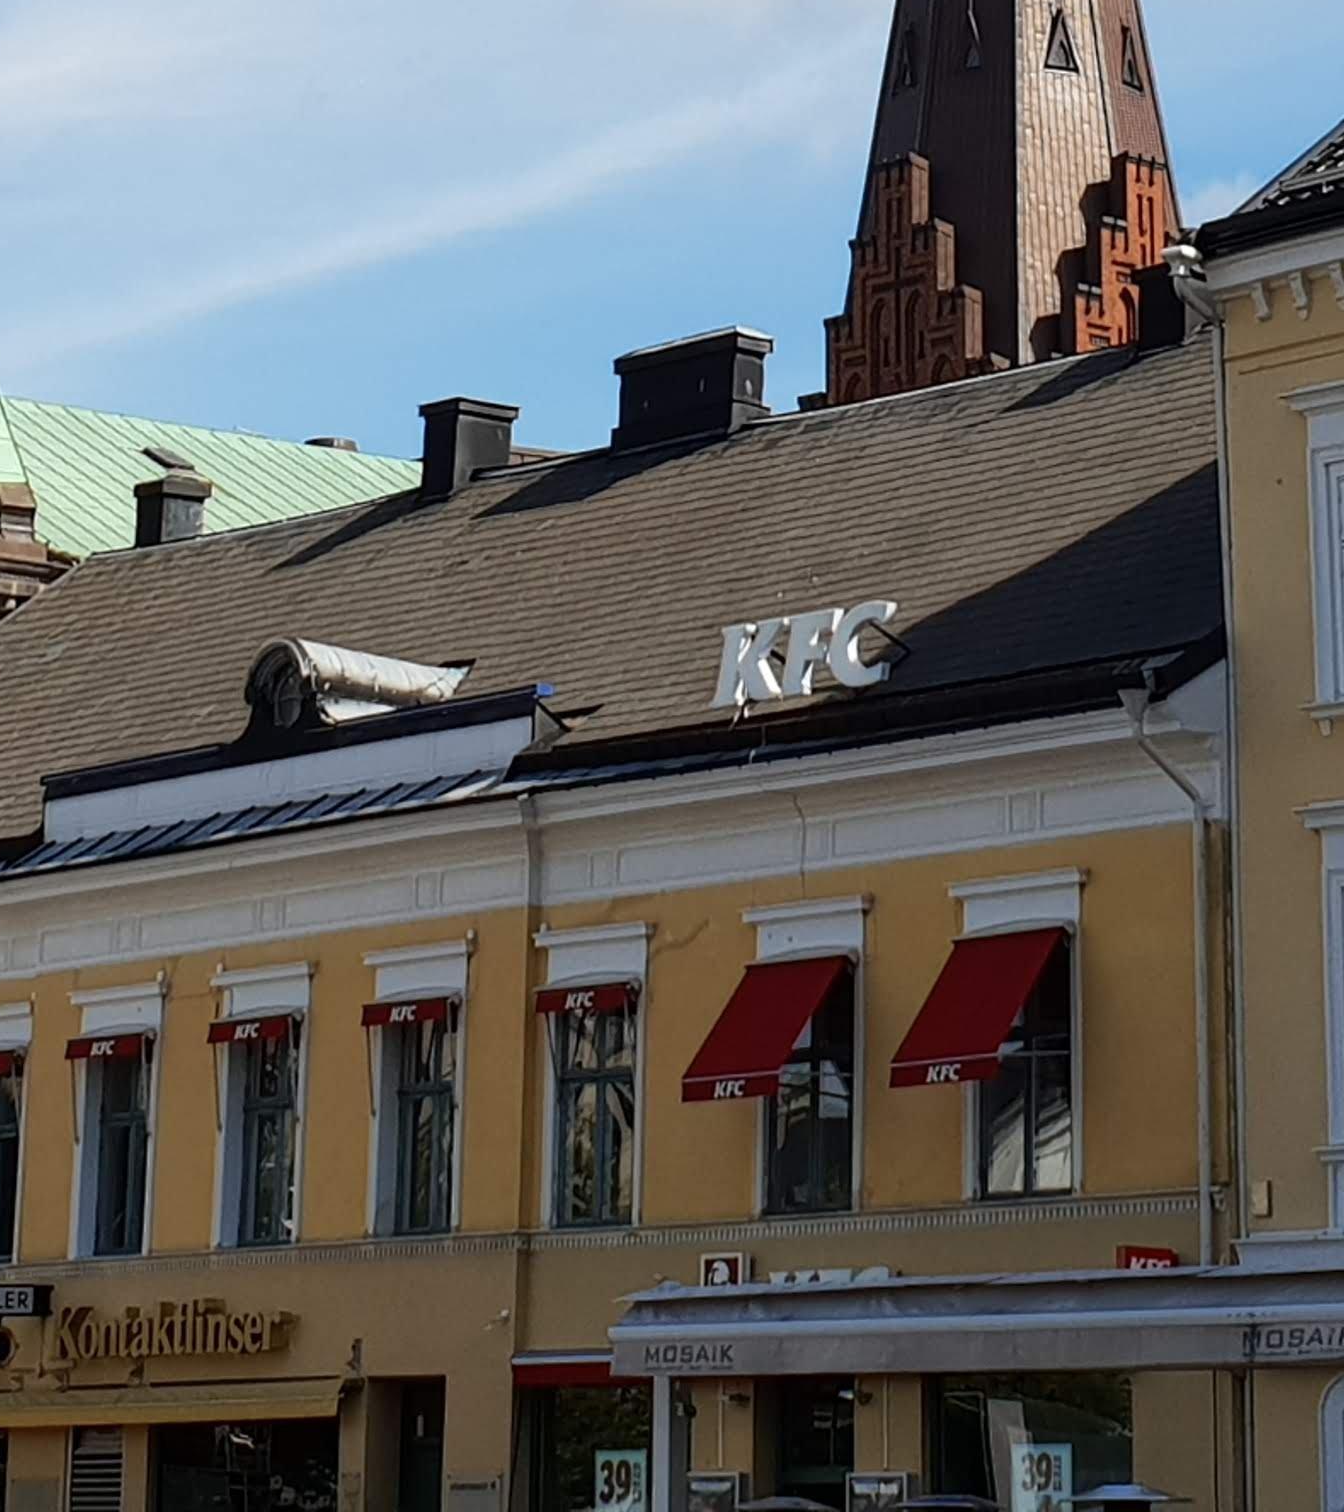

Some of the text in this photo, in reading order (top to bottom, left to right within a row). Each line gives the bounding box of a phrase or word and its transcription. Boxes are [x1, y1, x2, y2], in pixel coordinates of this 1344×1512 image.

[709, 599, 897, 709] KFC
[565, 991, 595, 1009] KFC
[389, 1005, 417, 1023] KFC
[234, 1023, 260, 1040] KFC
[90, 1040, 115, 1056] KFC
[926, 1063, 961, 1083] KFC
[714, 1080, 746, 1099] KFC
[53, 1299, 280, 1360] Kontaktlinser
[645, 1344, 733, 1364] MOSAIK
[600, 1460, 631, 1504] 39
[1022, 1453, 1052, 1491] 39
